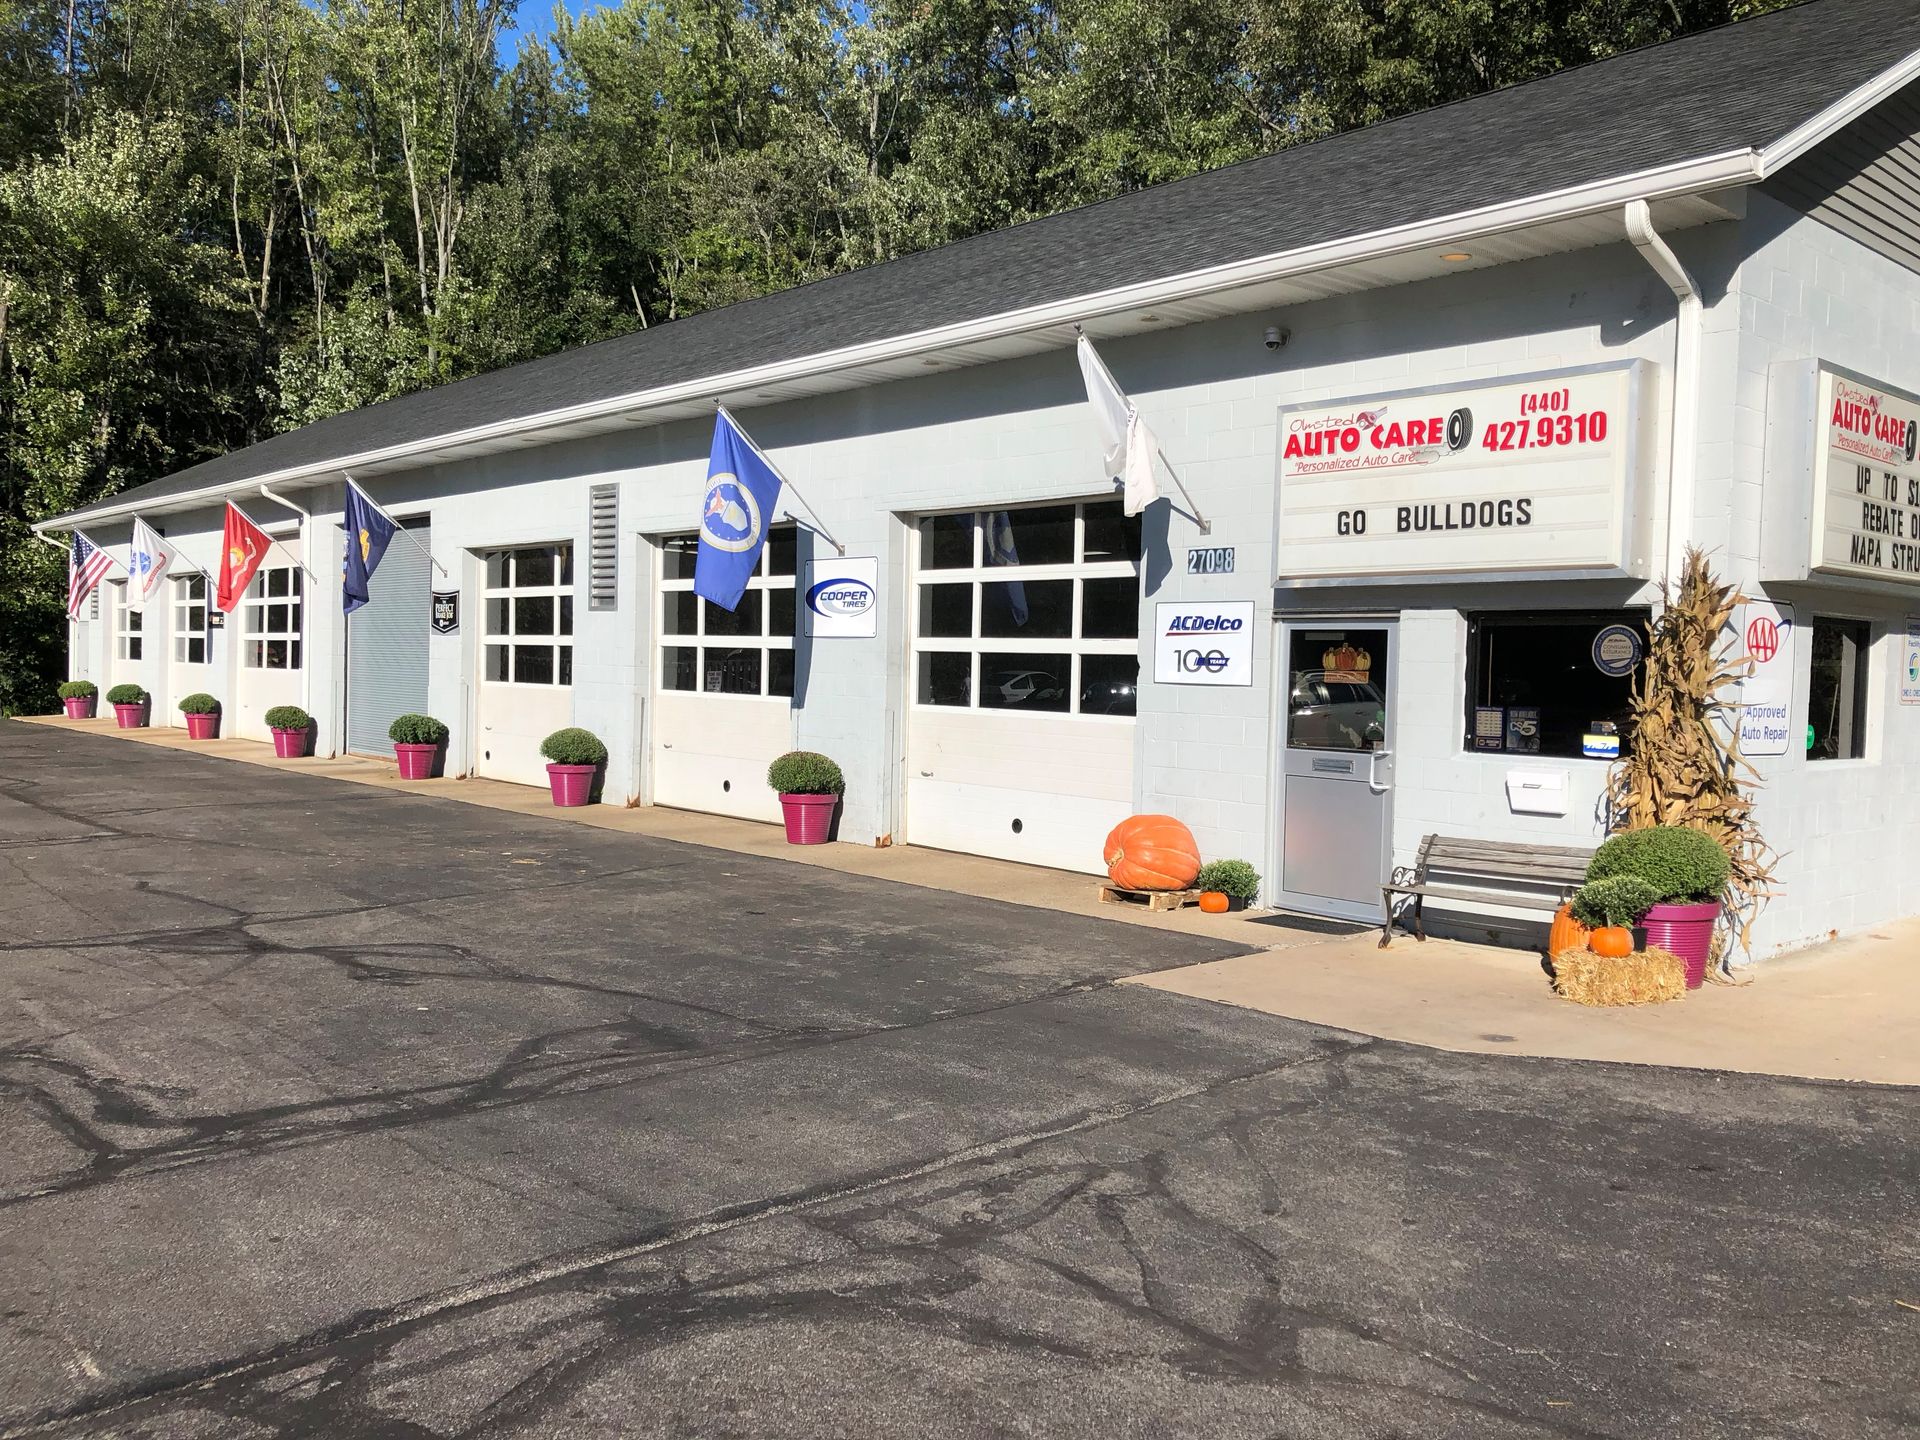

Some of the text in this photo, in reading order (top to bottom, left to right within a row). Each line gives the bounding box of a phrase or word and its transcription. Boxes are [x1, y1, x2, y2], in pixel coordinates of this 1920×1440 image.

[1290, 413, 1355, 433] Olmsted
[1482, 411, 1607, 452] 427.9310
[1832, 398, 1906, 448] AUTO CARE
[1283, 417, 1444, 459] AUTO CARE
[1362, 454, 1389, 467] Auto
[1857, 465, 1871, 495] UP
[1884, 473, 1898, 502] TO
[1337, 498, 1532, 535] GO BULLDOGS
[1863, 501, 1920, 540] REBATE O
[1189, 549, 1233, 574] 27098
[1851, 535, 1882, 567] NAPA
[820, 590, 868, 601] COOPER
[842, 600, 867, 608] TIRES
[1169, 615, 1243, 631] ACDelco
[1748, 618, 1778, 662] AAA
[1173, 649, 1225, 673] 100
[1746, 704, 1787, 722] Approved
[1742, 725, 1788, 743] Auto Repair
